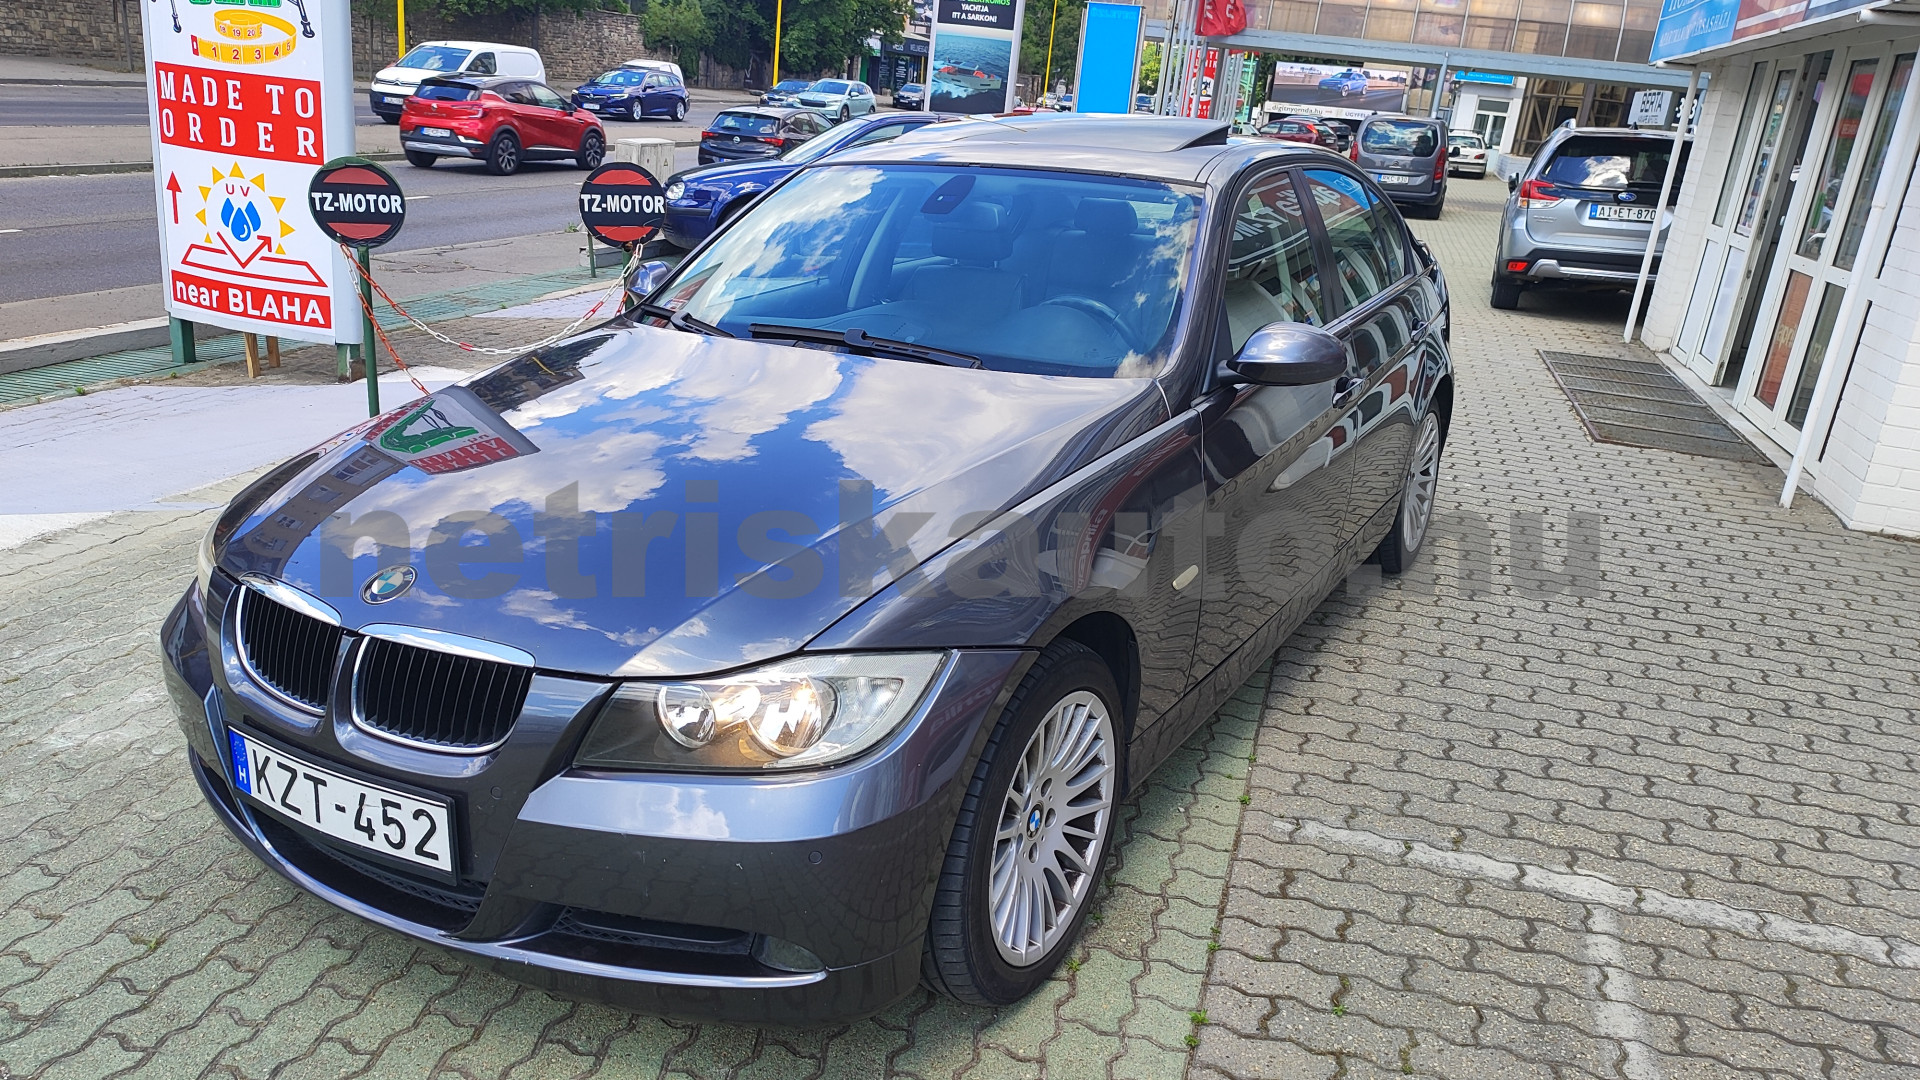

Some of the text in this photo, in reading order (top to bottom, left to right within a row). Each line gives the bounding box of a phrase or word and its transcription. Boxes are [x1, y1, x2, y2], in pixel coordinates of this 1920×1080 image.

[952, 11, 998, 23] ITT A SARKON!
[961, 3, 989, 13] YACHTJA
[232, 29, 241, 37] 19
[247, 29, 256, 37] 20
[211, 41, 291, 60] 1 2 3 4 5
[158, 70, 315, 119] MADE TO
[1640, 92, 1664, 113] BERTA
[161, 108, 318, 158] ORDER
[311, 192, 404, 214] TZ-MOTOR
[580, 193, 666, 214] TZ-MOTOR
[175, 279, 325, 325] near BLAHA
[238, 765, 248, 786] H
[251, 748, 440, 862] KZT-452
